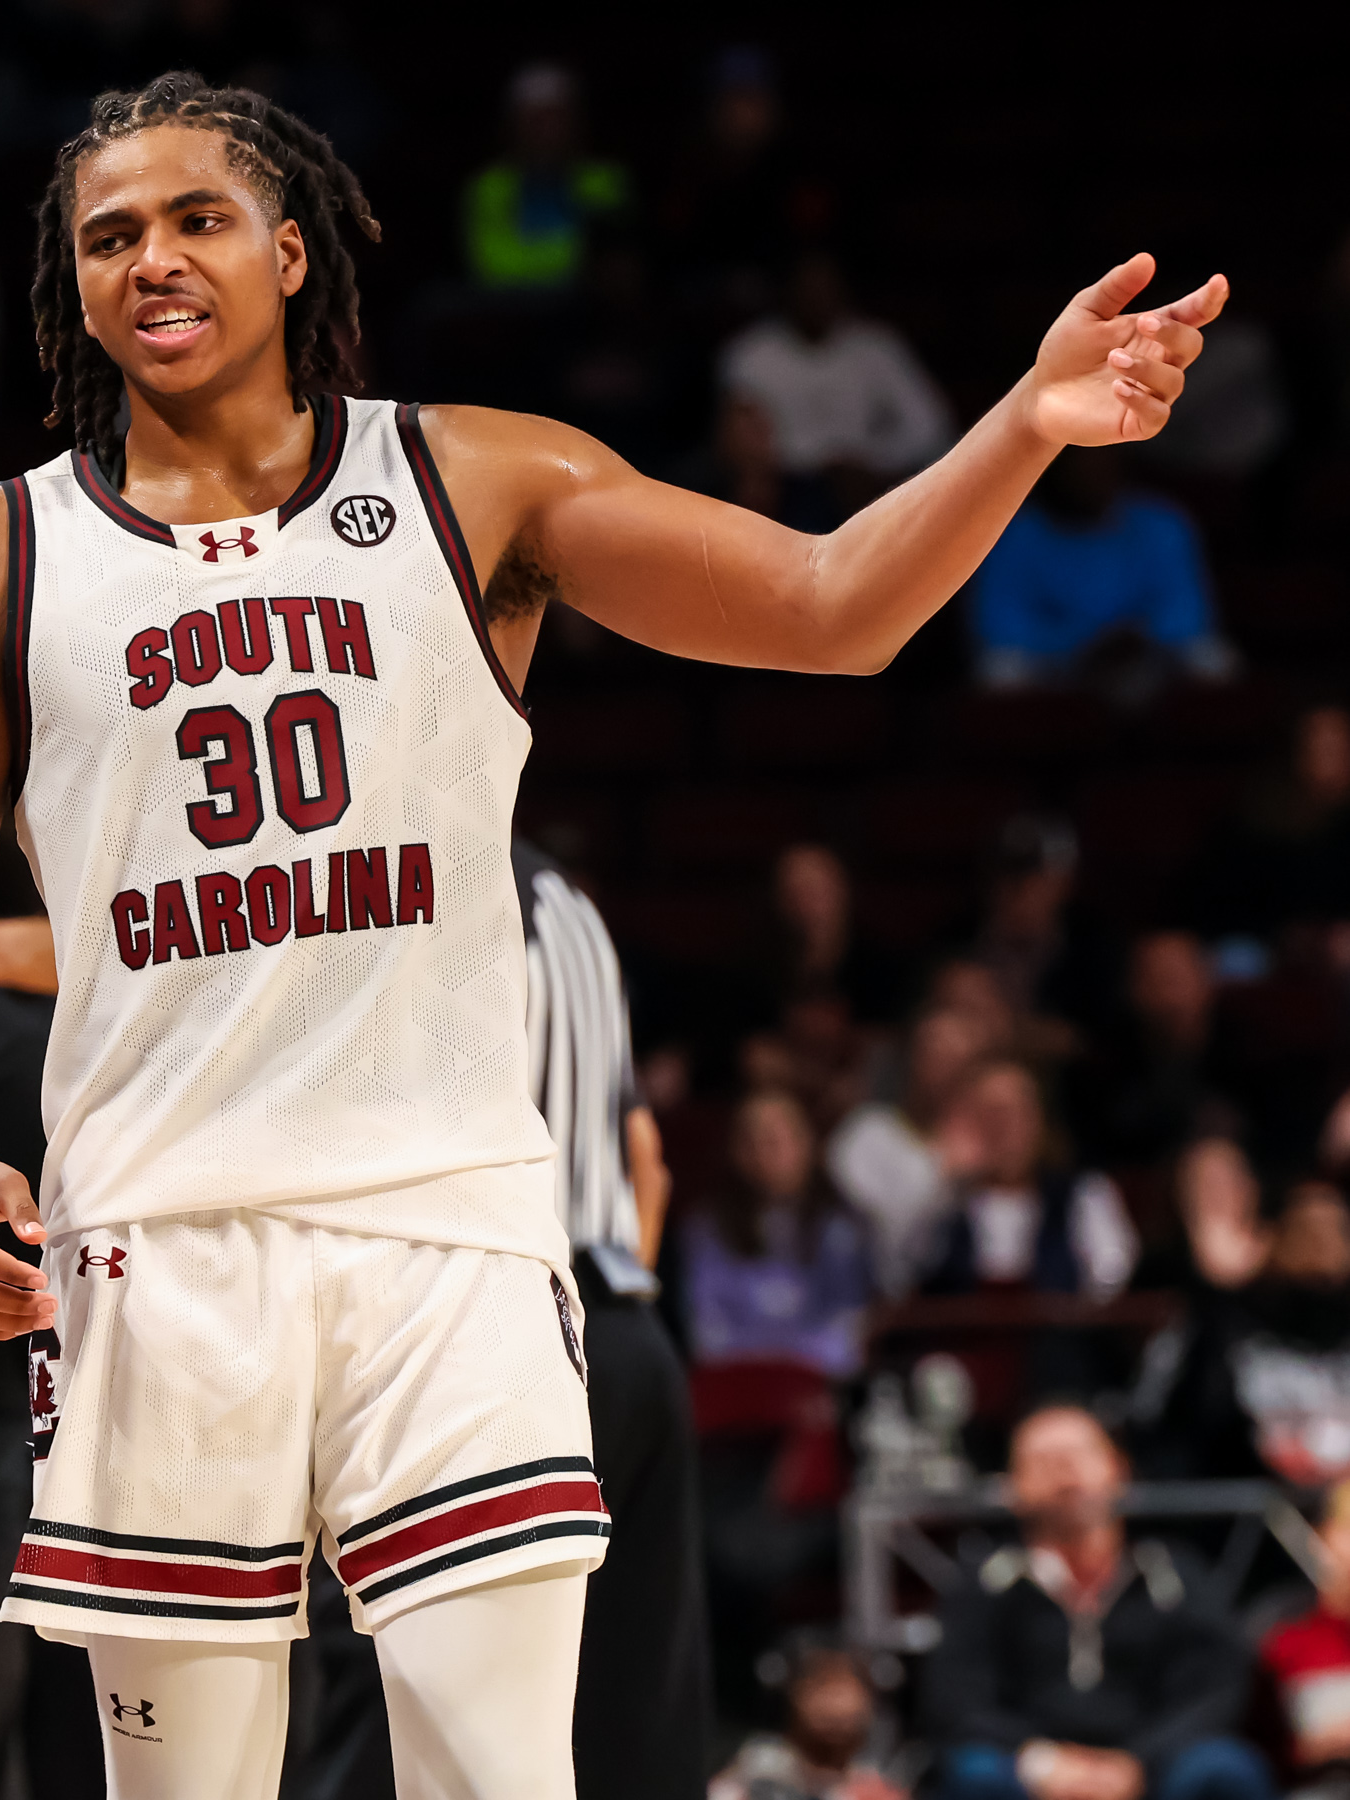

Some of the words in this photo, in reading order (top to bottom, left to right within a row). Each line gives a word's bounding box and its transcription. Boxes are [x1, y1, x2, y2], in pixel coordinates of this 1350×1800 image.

[337, 499, 391, 542] SEC
[125, 596, 378, 711] SOUTH
[176, 688, 352, 850] 30
[110, 843, 434, 971] CAROLINA
[132, 1733, 163, 1743] ARMOUR
